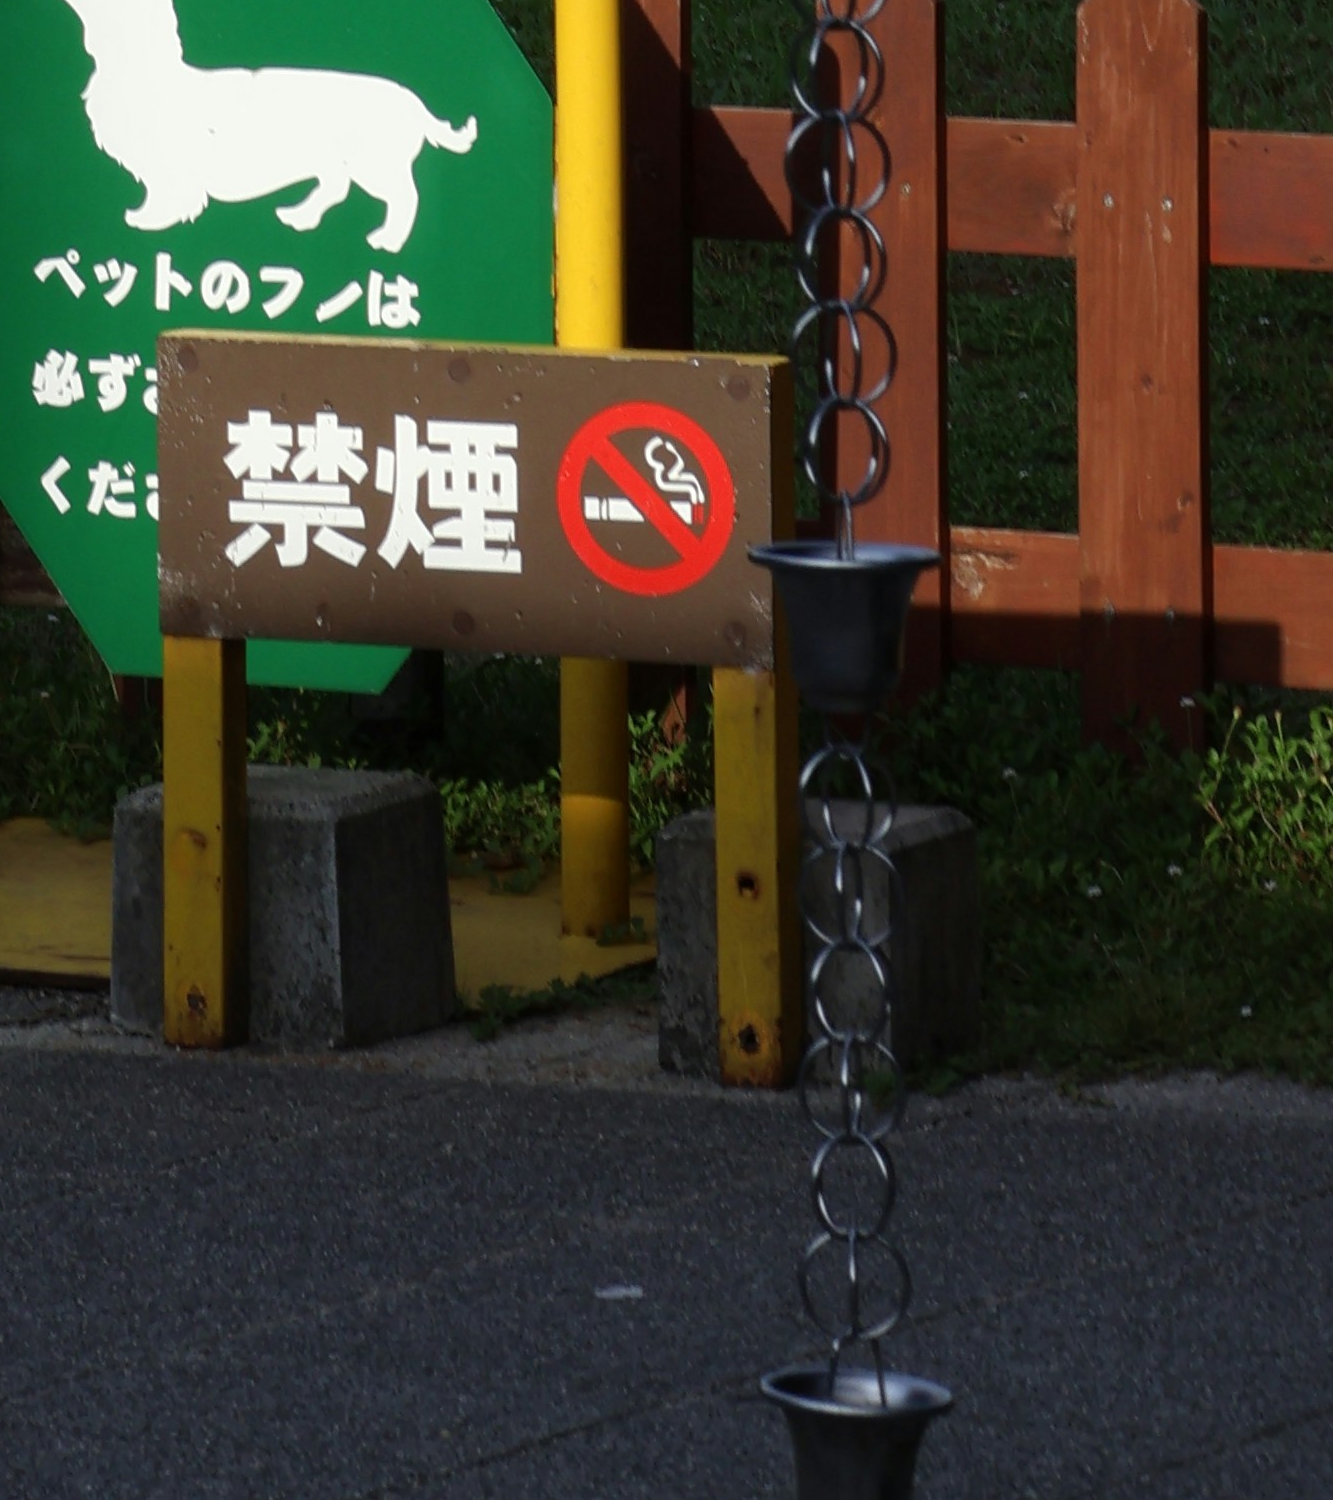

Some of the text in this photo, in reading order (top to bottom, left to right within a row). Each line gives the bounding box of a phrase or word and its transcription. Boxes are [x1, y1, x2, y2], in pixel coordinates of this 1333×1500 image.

[32, 348, 159, 416] 必ず
[40, 455, 160, 522] くだ
[223, 410, 523, 574] 禁煙
